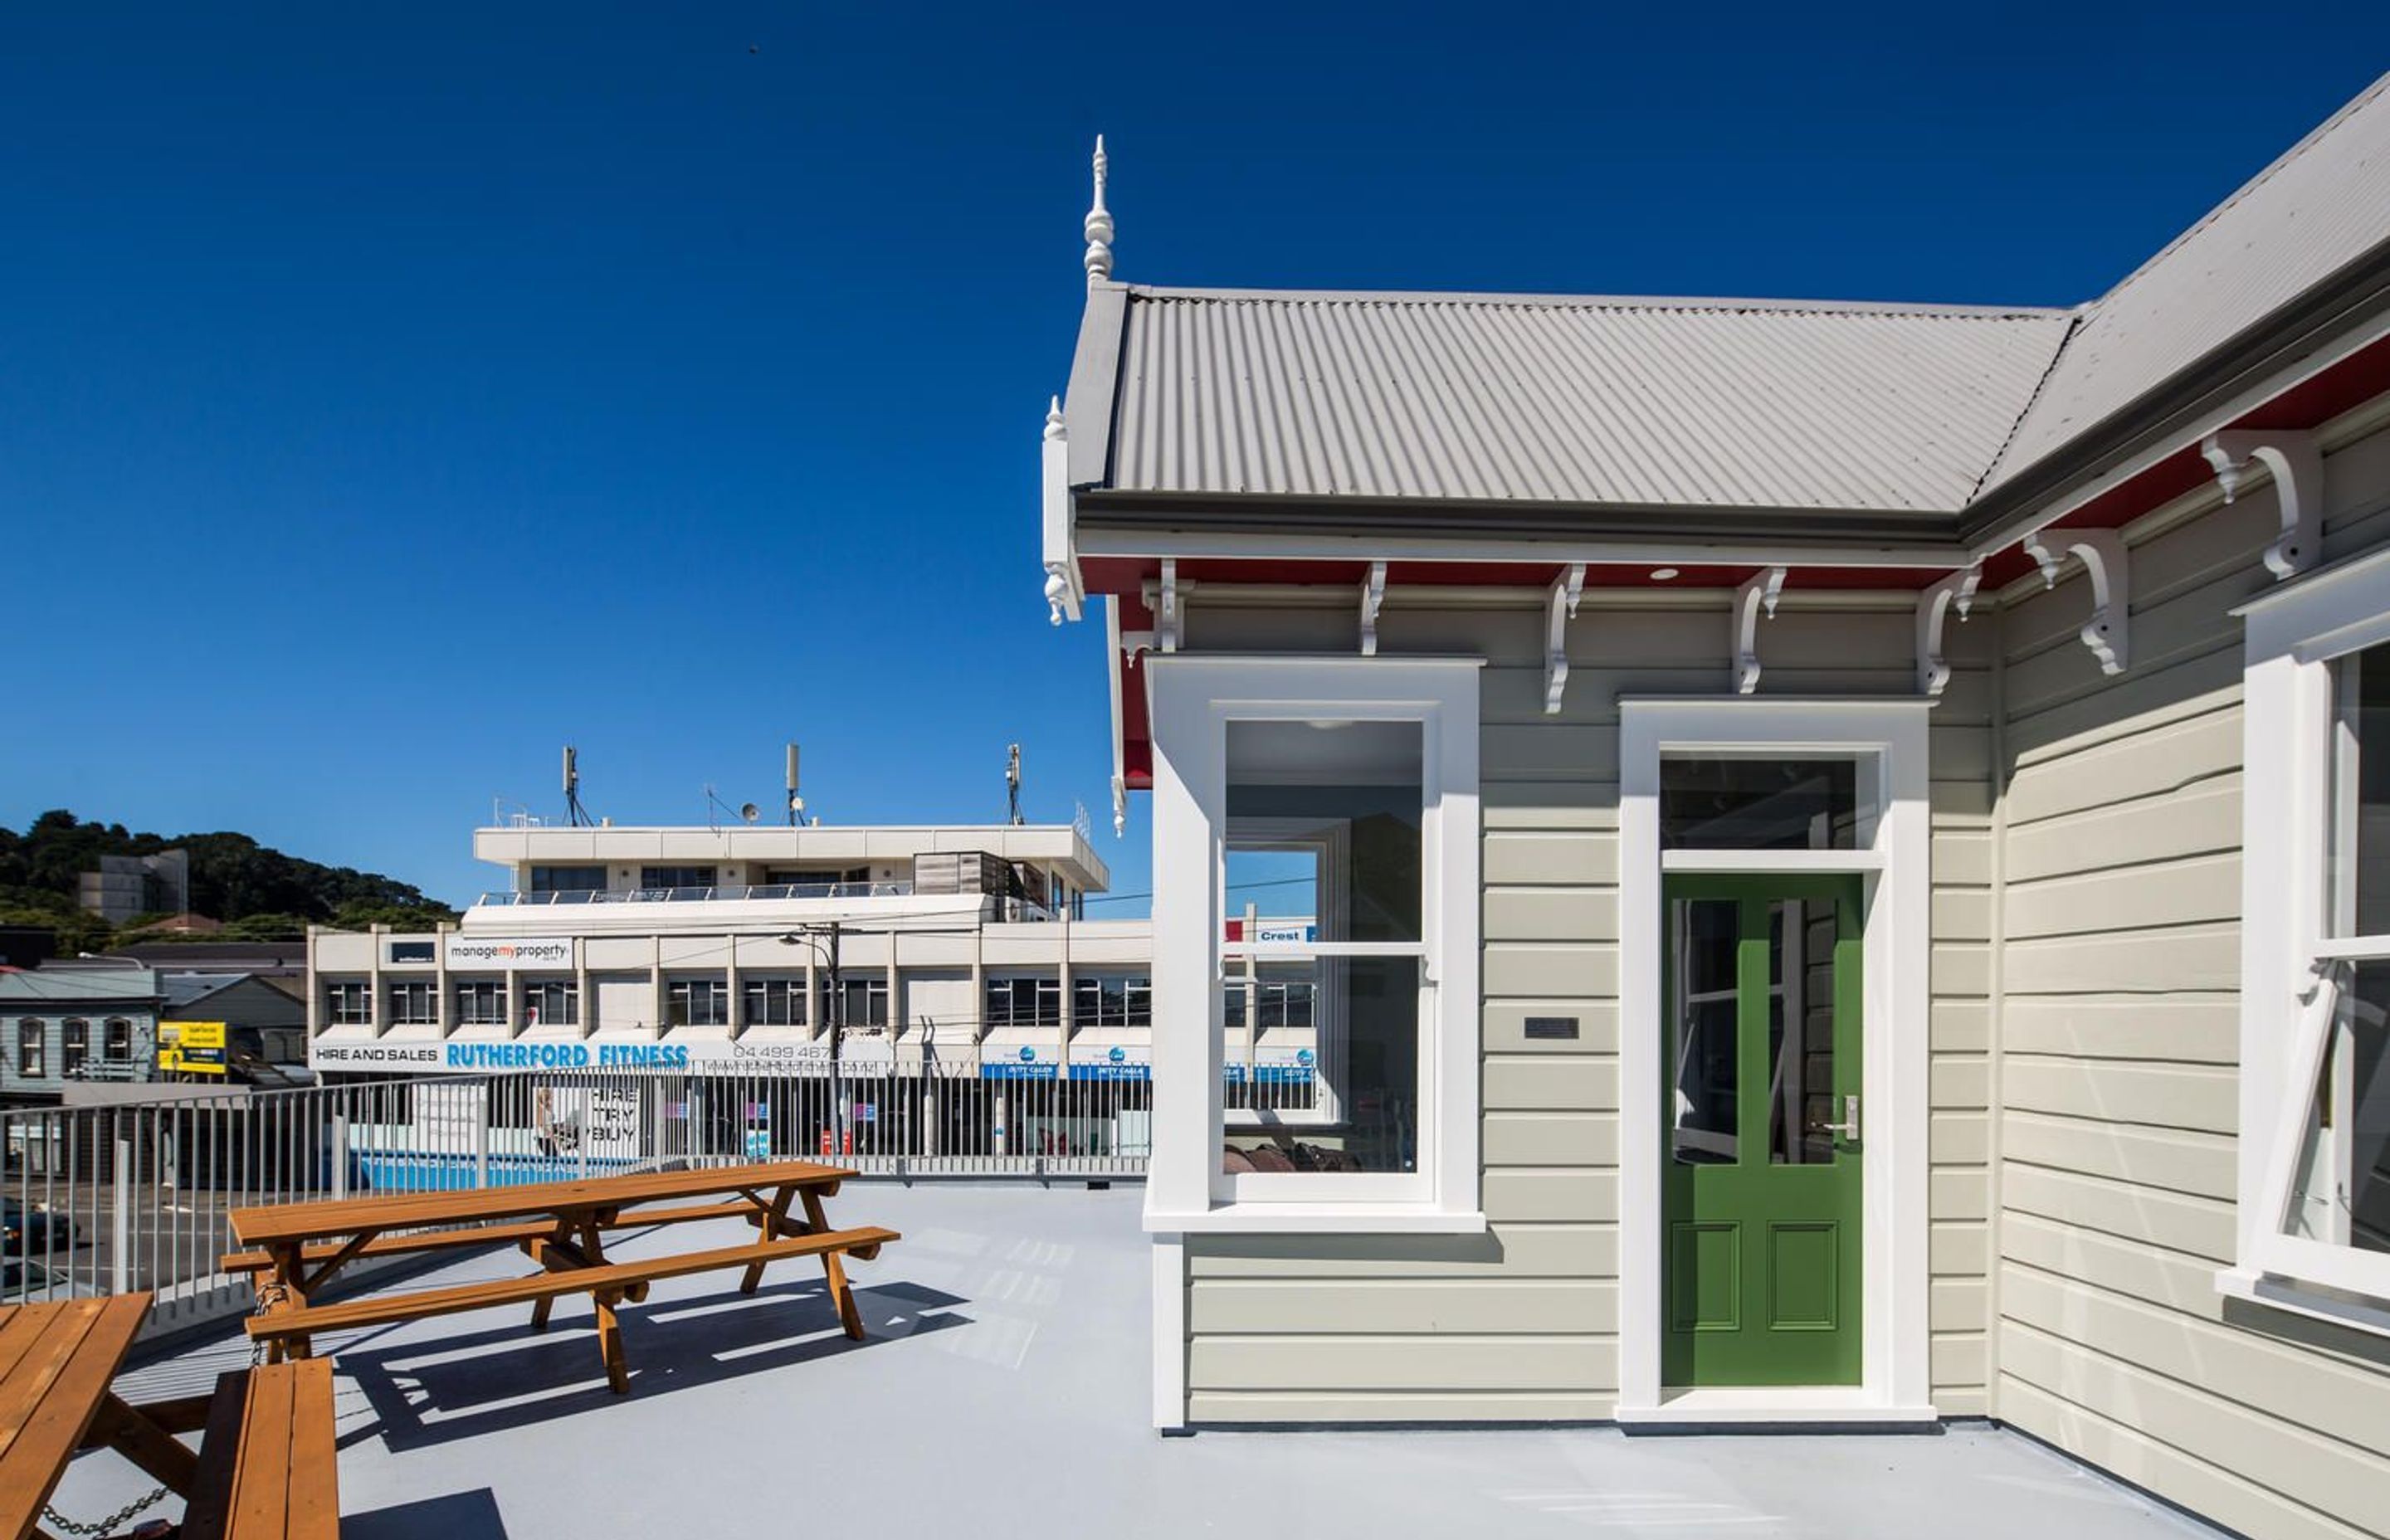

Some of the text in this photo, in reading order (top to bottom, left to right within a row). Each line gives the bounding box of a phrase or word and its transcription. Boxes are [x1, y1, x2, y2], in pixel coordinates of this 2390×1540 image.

[1261, 931, 1300, 941] Crest
[451, 944, 567, 960] managemyproperty
[316, 1048, 438, 1061] HIRE AND SALES
[446, 1043, 690, 1070] RUTHERFORD FITNESS
[734, 1046, 755, 1058] 04
[760, 1046, 793, 1058] 499
